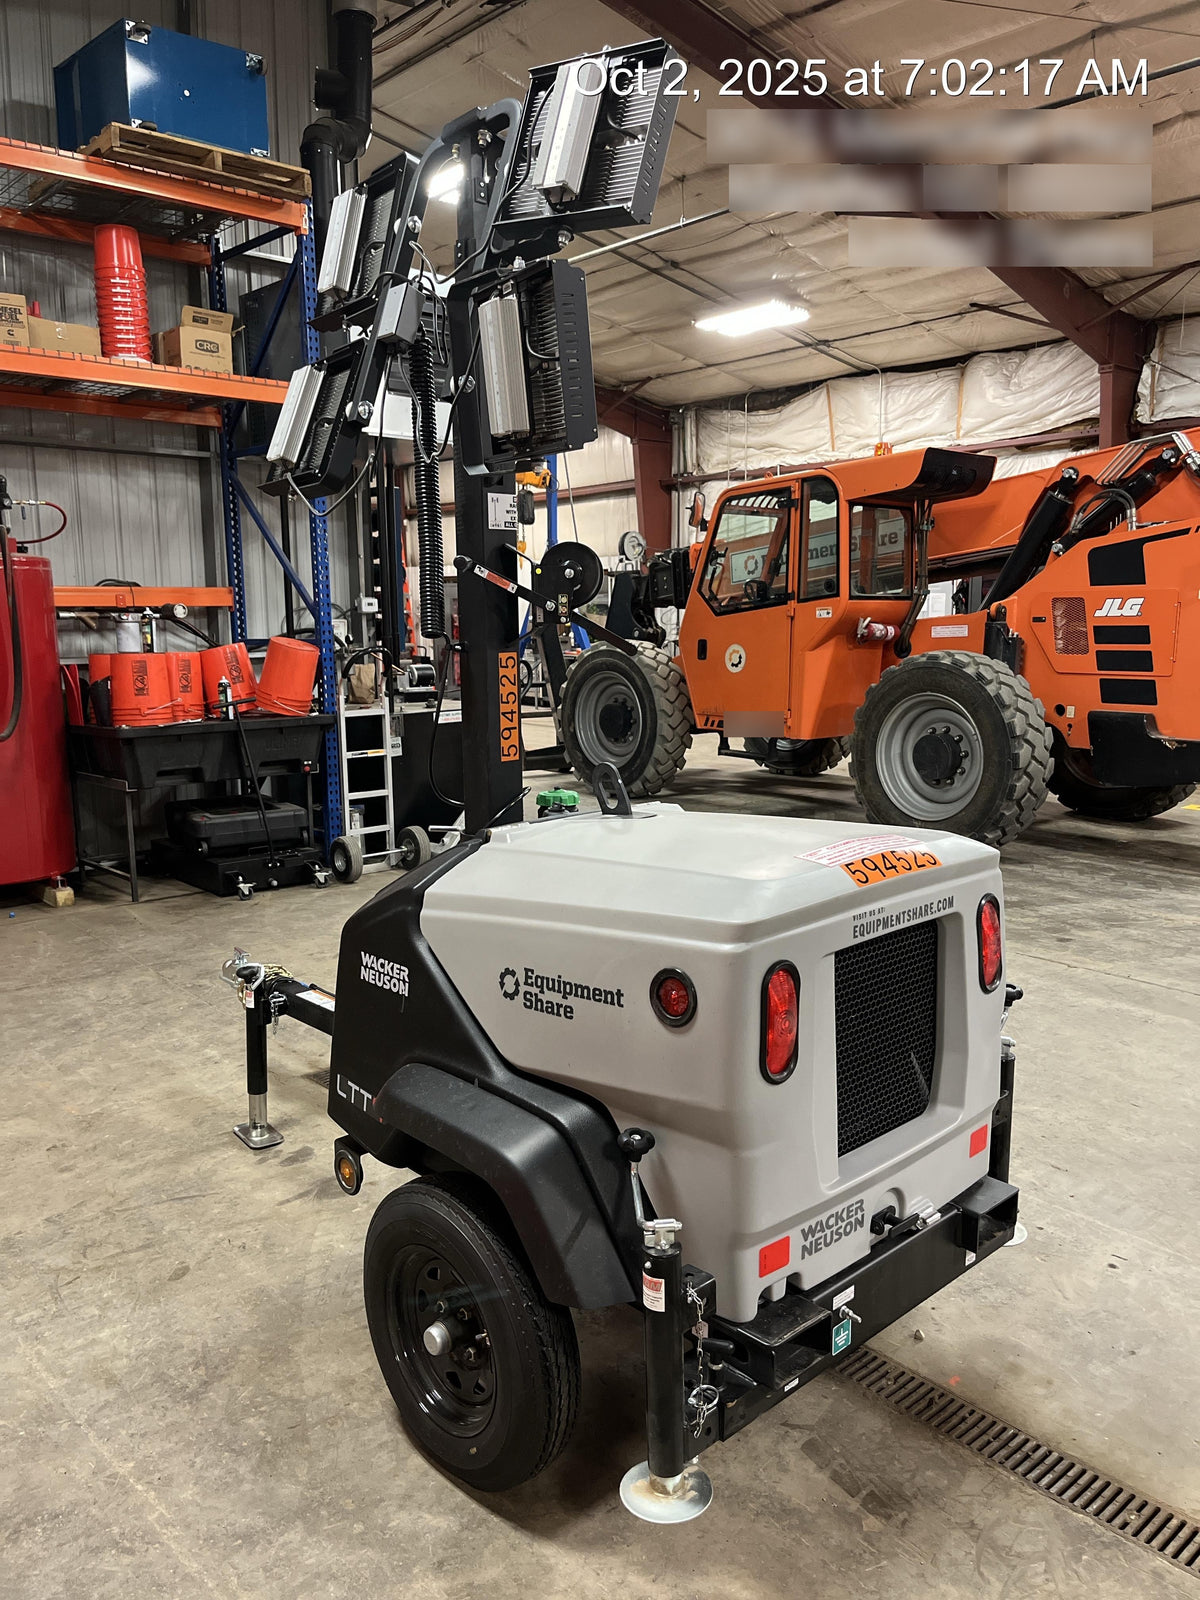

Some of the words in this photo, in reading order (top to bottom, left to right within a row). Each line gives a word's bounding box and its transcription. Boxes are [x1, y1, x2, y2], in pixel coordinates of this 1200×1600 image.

[196, 341, 218, 352] CRC
[1094, 597, 1145, 617] JLG
[500, 655, 518, 757] 594525
[852, 912, 867, 921] VISIT
[853, 896, 954, 938] EQUIPMENTSHARE.COM
[361, 951, 409, 982] WACKER
[361, 966, 409, 997] NEUSON
[523, 967, 624, 1008] Equipment
[523, 991, 574, 1020] Share
[337, 1074, 376, 1112] LTT
[801, 1199, 865, 1242] WACKER
[801, 1213, 865, 1260] NEUSON
